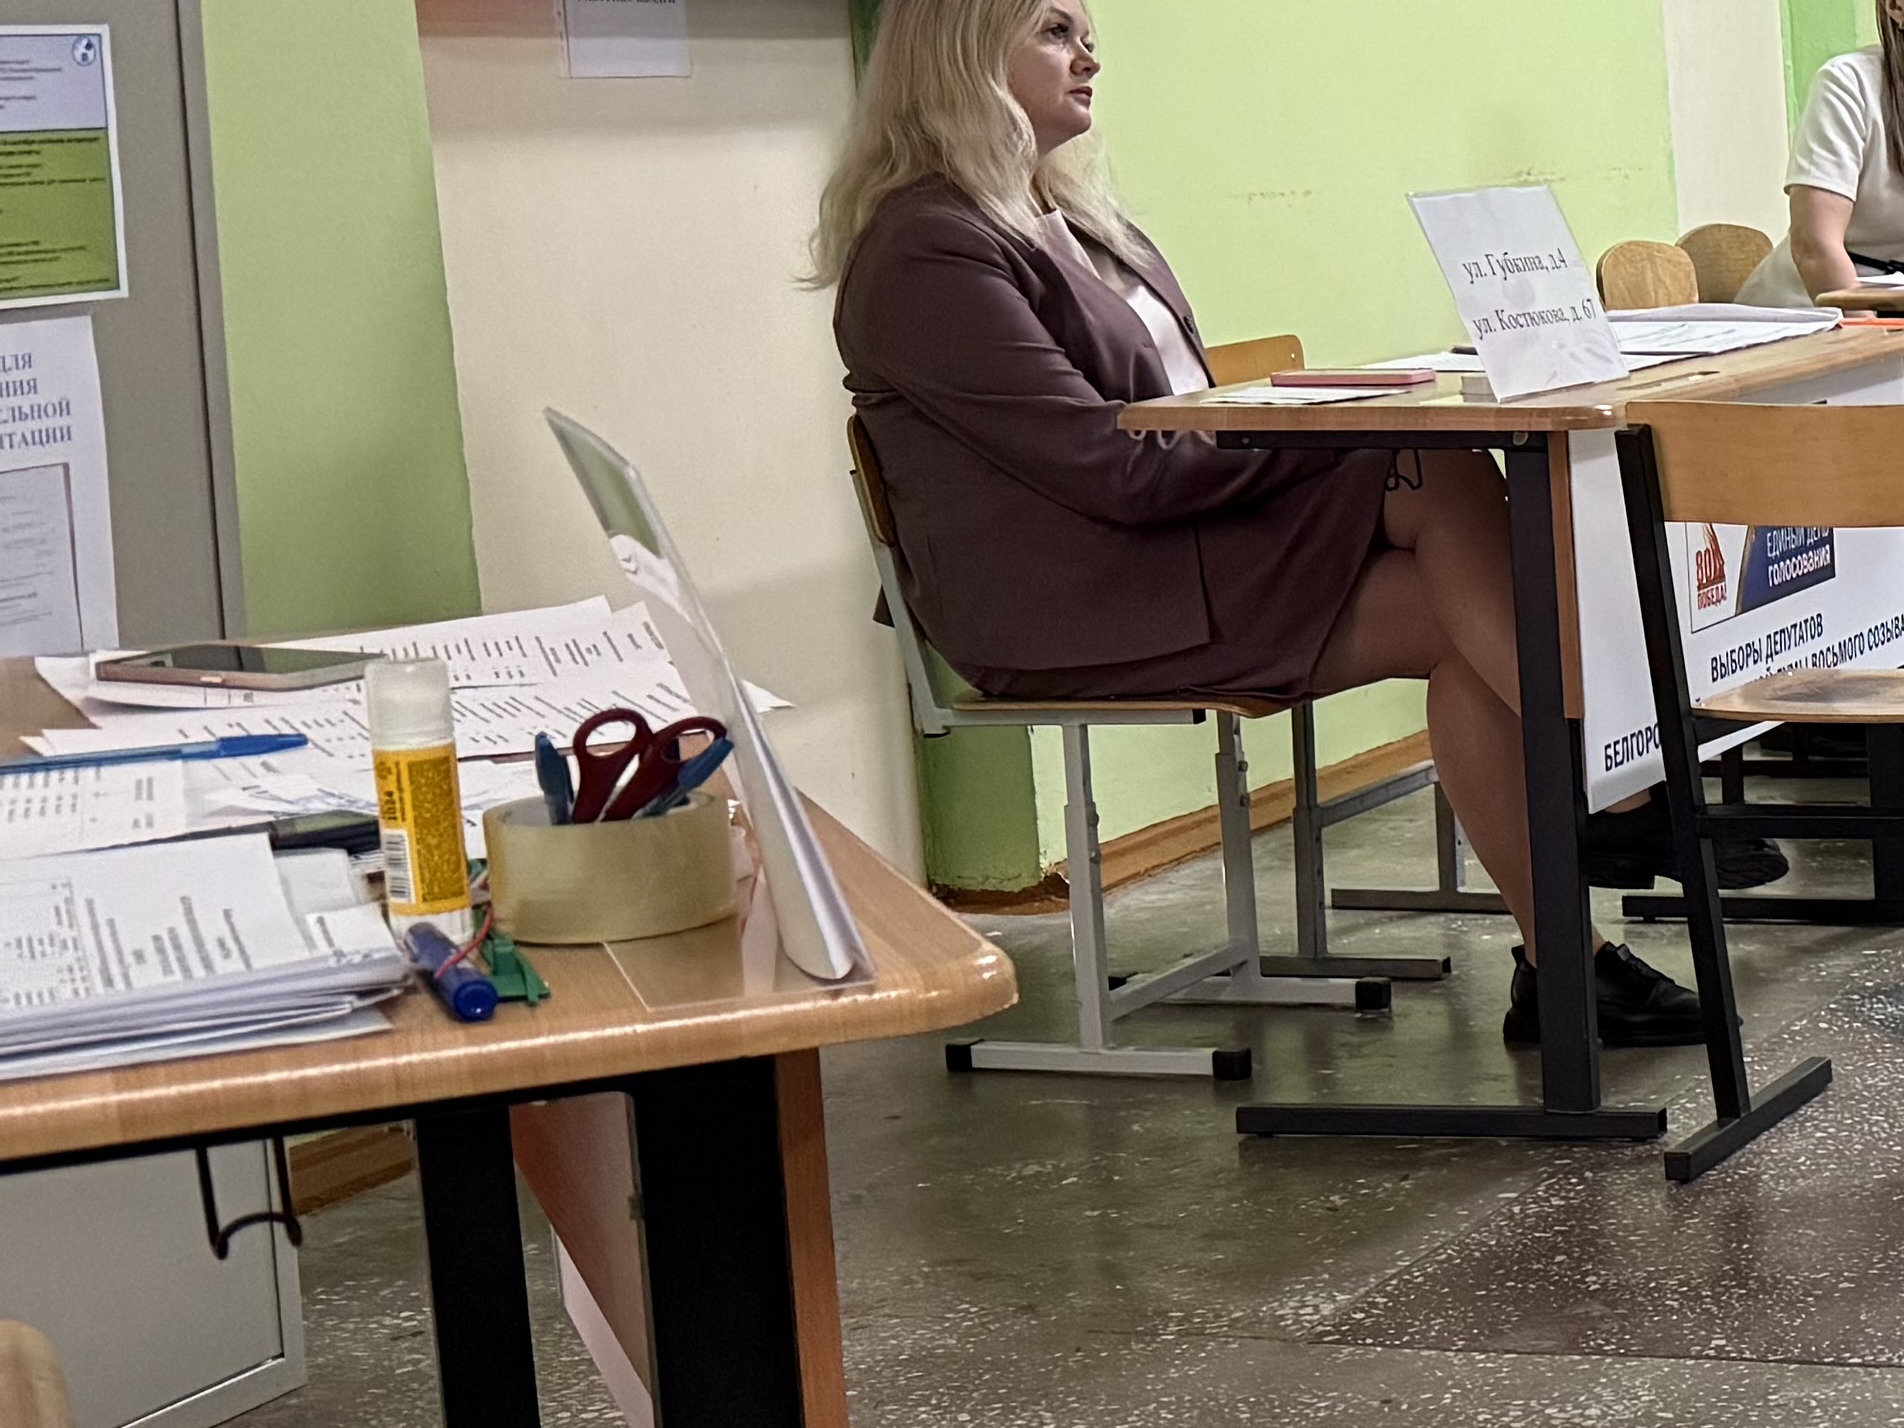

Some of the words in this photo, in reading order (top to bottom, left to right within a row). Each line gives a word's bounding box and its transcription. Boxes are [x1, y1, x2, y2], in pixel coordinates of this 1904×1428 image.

[1462, 262, 1487, 284] ул.
[1484, 251, 1549, 281] Губкина,
[1472, 319, 1496, 340] ул.
[1494, 308, 1570, 332] Костюкова,
[1581, 298, 1597, 320] 67
[0, 396, 70, 424] ЛЬНОЙ
[1711, 637, 1763, 684] ВЫБОРЫ
[1765, 612, 1824, 665] ДЕПУТАТОВ
[1811, 631, 1866, 670] ВОСЬМОГО
